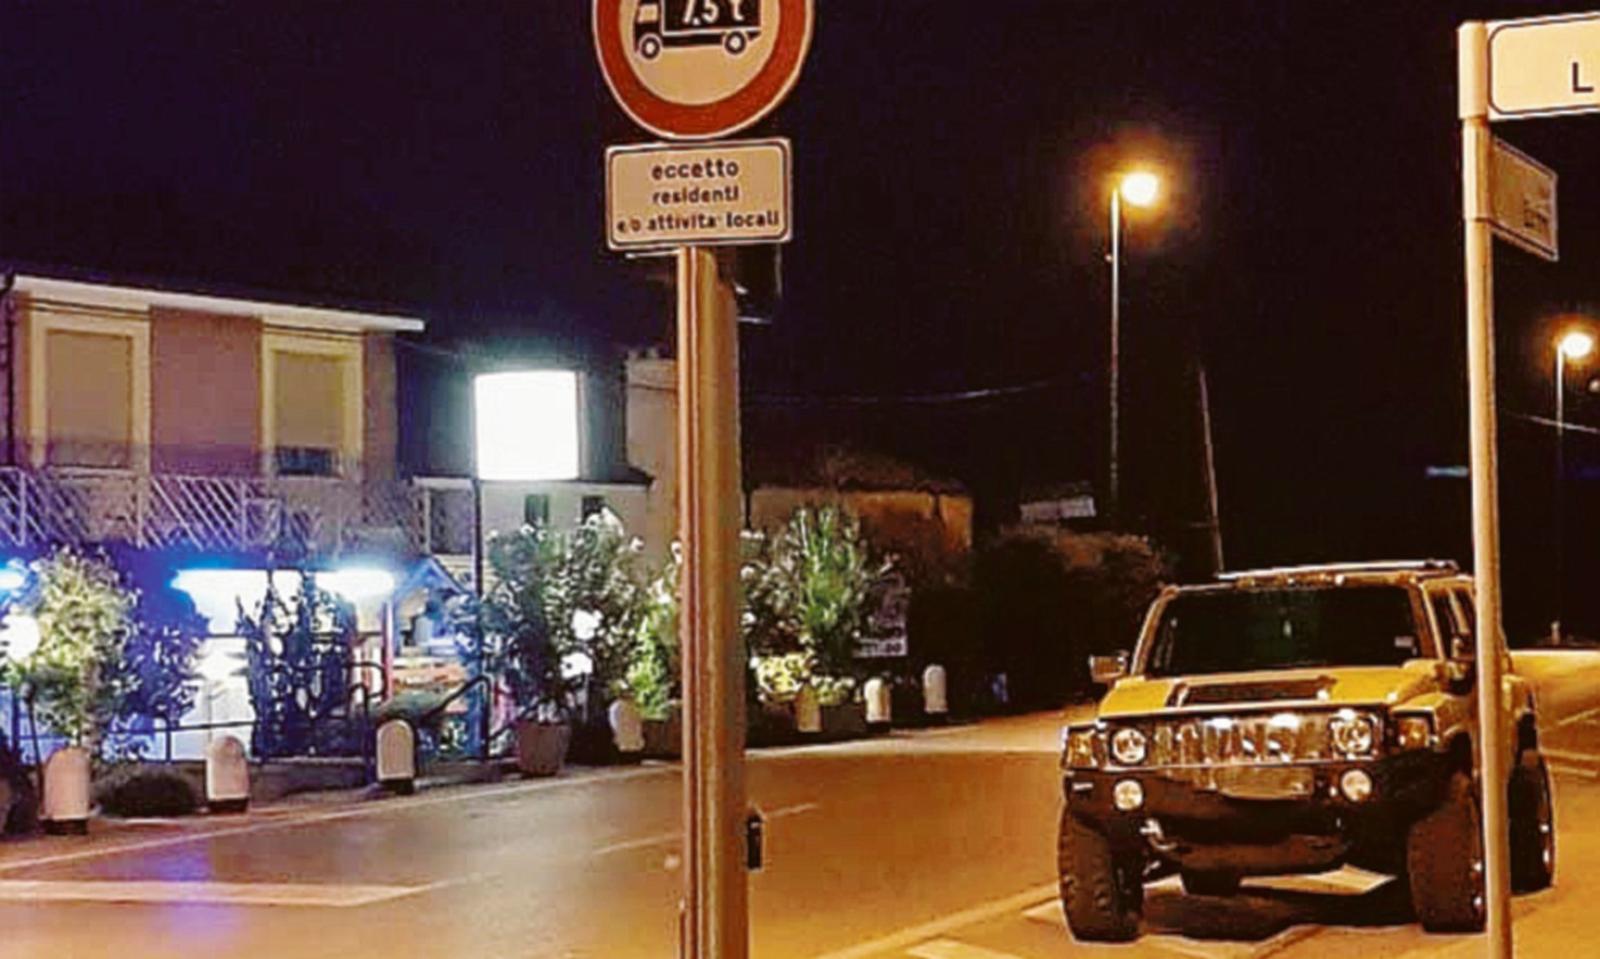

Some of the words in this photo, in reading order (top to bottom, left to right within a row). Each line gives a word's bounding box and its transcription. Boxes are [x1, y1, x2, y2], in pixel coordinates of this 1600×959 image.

[1572, 61, 1594, 93] L
[651, 158, 739, 180] eccetto
[652, 186, 739, 204] residenti
[726, 209, 779, 228] locali
